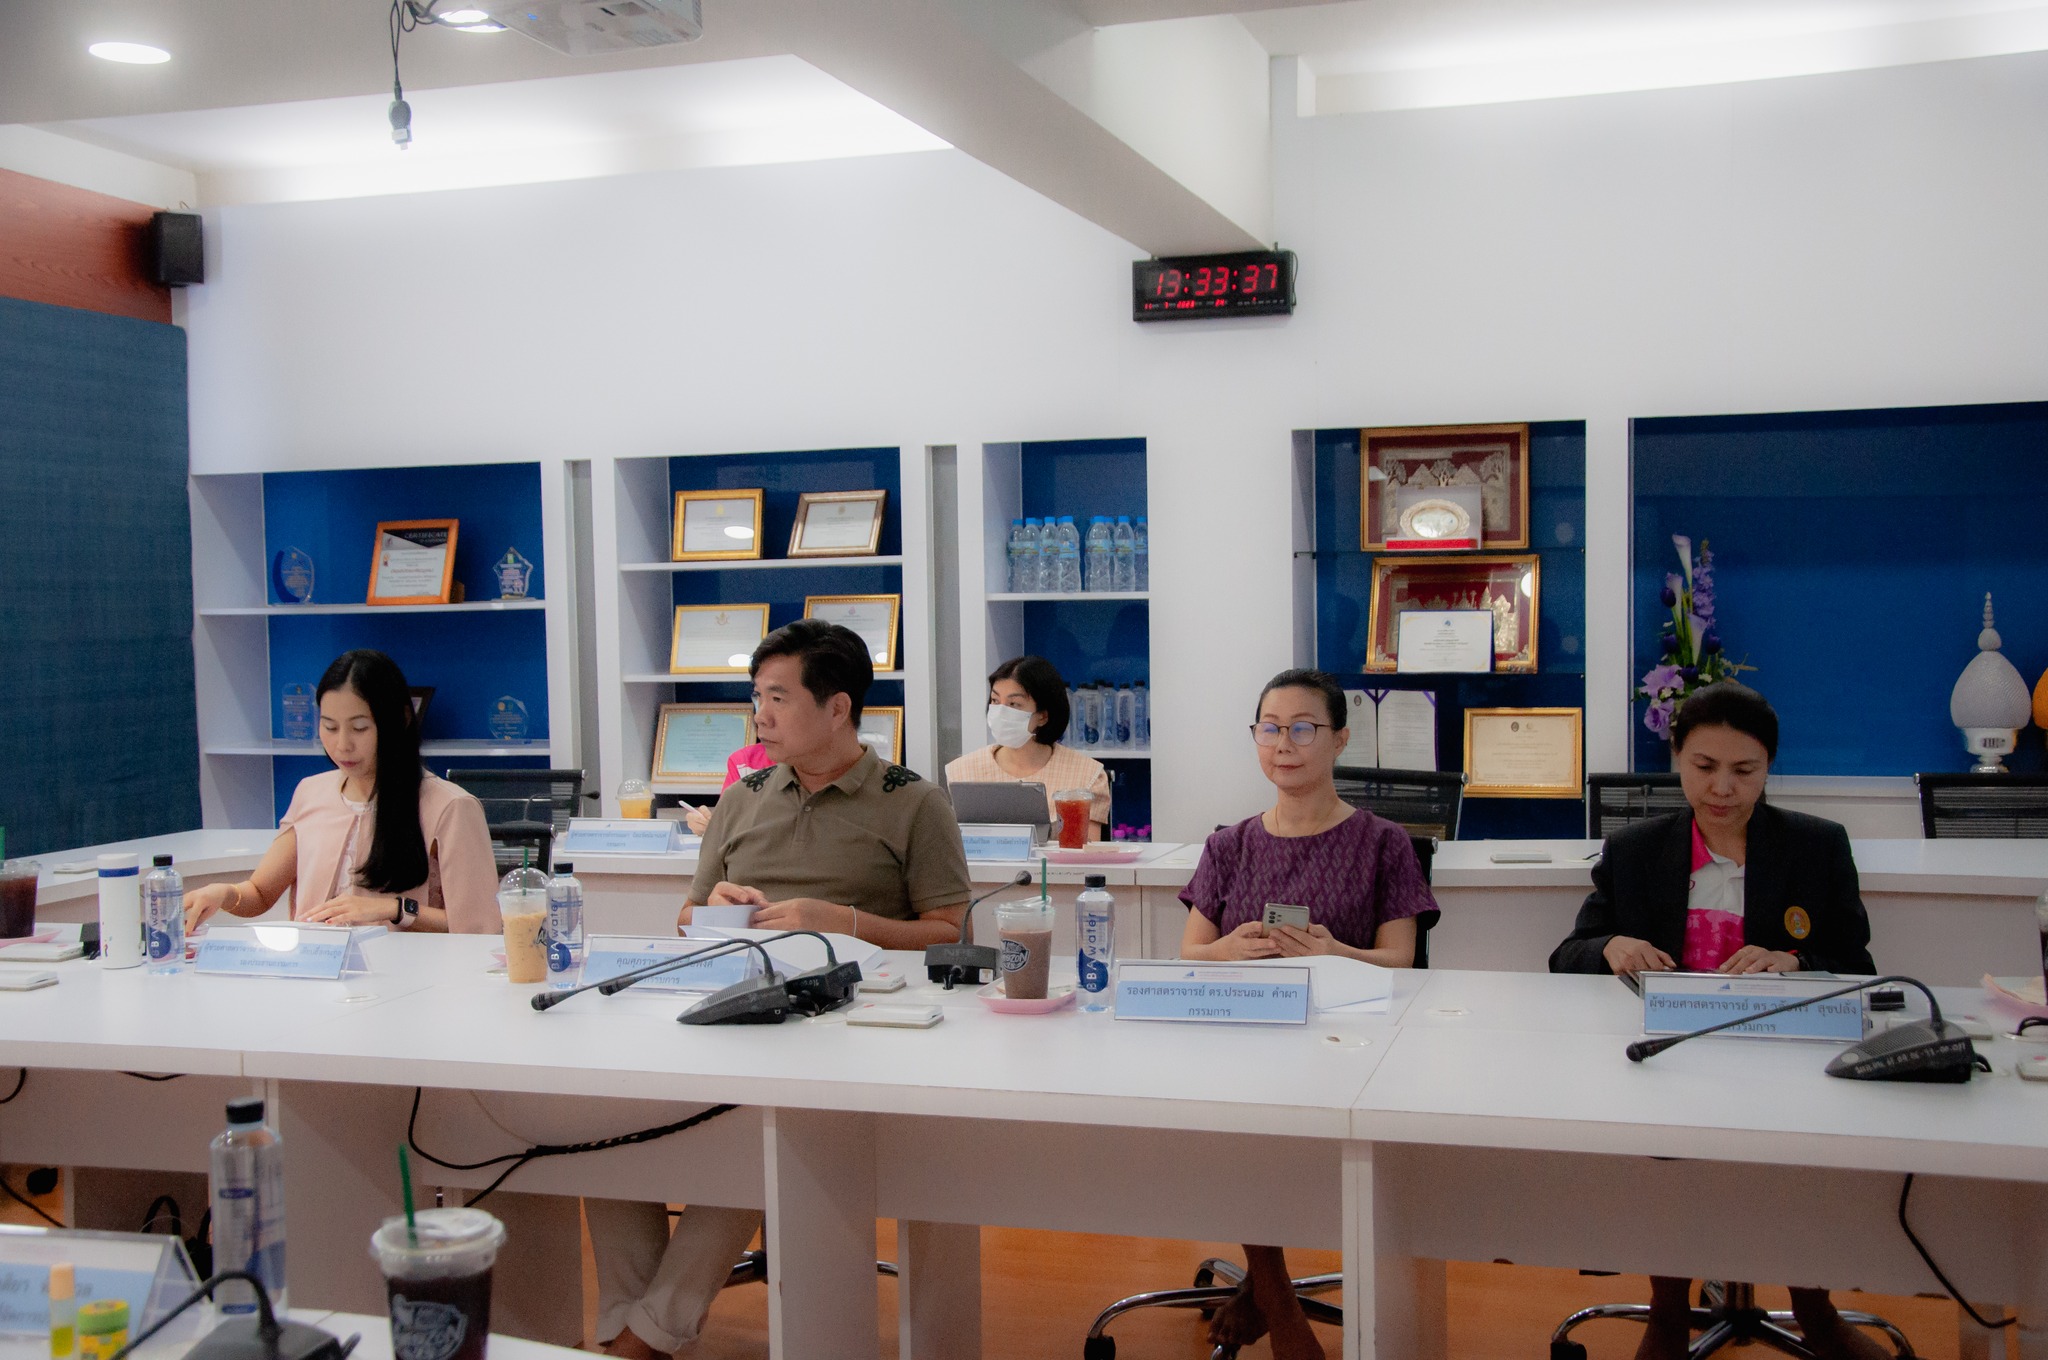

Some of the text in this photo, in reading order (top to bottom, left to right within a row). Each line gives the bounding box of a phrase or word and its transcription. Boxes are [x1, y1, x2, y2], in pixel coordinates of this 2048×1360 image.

[1156, 264, 1278, 297] 13:33:37
[1086, 959, 1097, 990] BBA
[1126, 985, 1205, 997] รองศาสตราจารย์
[1208, 986, 1265, 998] ดร.ประนอม
[1188, 1007, 1231, 1017] กรรมการ
[1649, 996, 1749, 1012] ผู้ช่วยศาสตราจารย์
